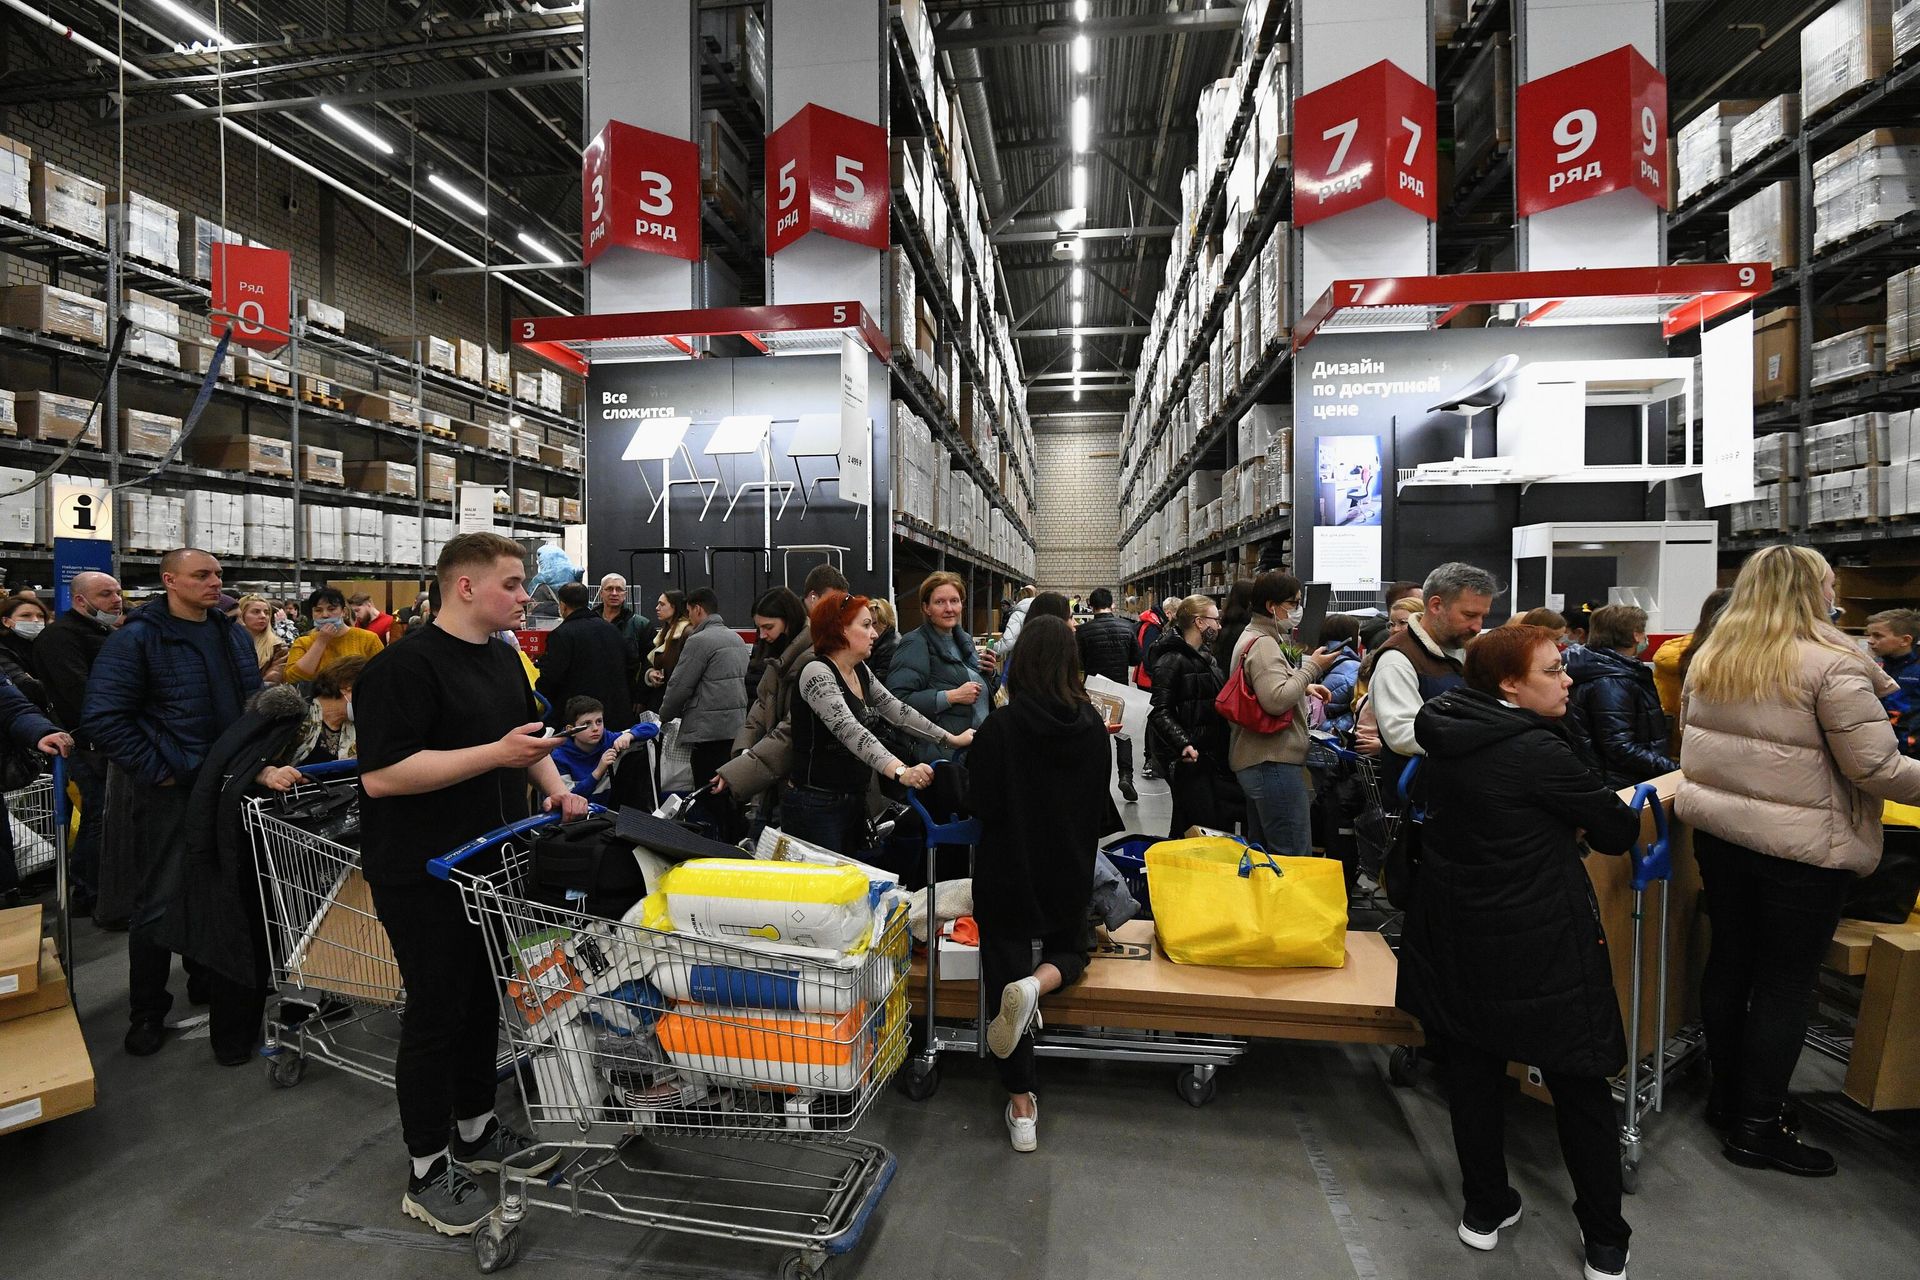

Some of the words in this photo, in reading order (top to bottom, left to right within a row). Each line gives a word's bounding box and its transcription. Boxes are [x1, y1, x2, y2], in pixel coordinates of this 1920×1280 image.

[1401, 115, 1422, 167] 7
[1552, 108, 1598, 164] 9
[1641, 106, 1657, 156] 9
[1322, 117, 1359, 176] 7
[778, 158, 797, 210] 5
[834, 154, 865, 203] 5
[1398, 170, 1425, 198] ряд
[1549, 160, 1603, 193] ряд
[1640, 160, 1660, 188] ряд
[591, 174, 604, 222] 3
[639, 170, 674, 217] 3
[1318, 173, 1362, 205] ряд
[635, 218, 678, 242] ряд
[777, 208, 799, 237] ряд
[832, 206, 870, 231] ряд
[590, 221, 605, 248] ряд
[239, 281, 265, 295] Ряд
[1737, 266, 1756, 287] 9
[1348, 283, 1365, 303] 7
[833, 305, 847, 324] 5
[862, 311, 867, 329] 5
[522, 321, 536, 340] 3
[1311, 357, 1385, 379] Дизайн
[602, 391, 628, 405] Все
[1312, 383, 1337, 397] по
[1339, 375, 1441, 399] доступной
[602, 406, 676, 420] сложится
[1313, 403, 1360, 420] цене
